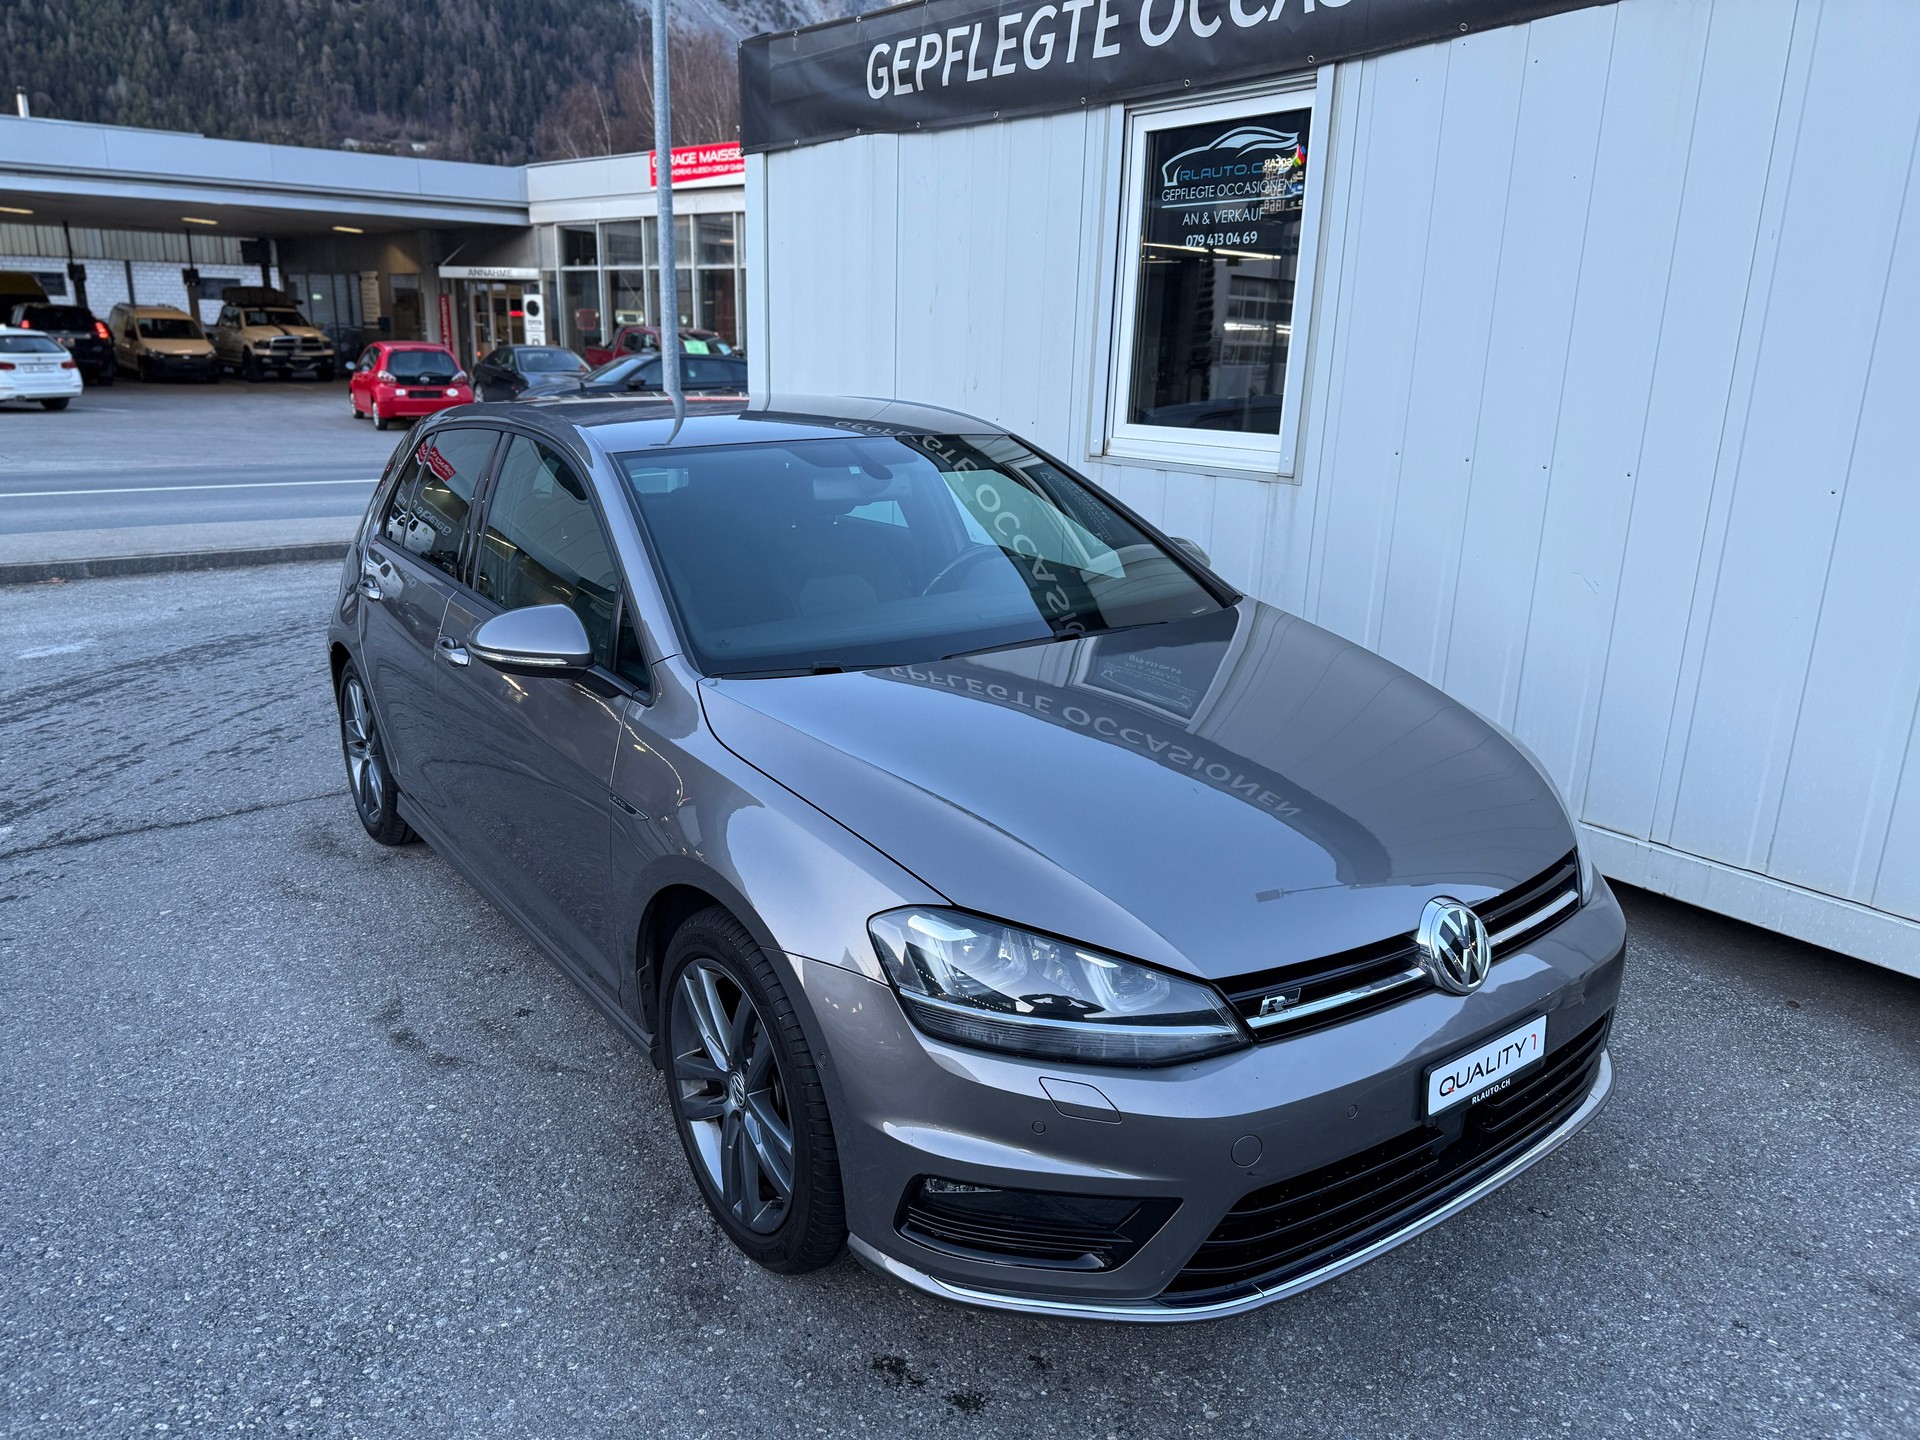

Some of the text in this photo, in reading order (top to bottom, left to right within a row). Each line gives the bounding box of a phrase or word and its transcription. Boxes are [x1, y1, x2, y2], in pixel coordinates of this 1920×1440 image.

[866, 0, 1120, 99] GEPFLEGTE
[1180, 162, 1272, 181] RLAUTO.C
[1161, 185, 1215, 202] GEPFLEGTE
[1216, 178, 1293, 197] OCCASIONEN
[1181, 207, 1265, 226] AN & VERKAUF
[1186, 230, 1258, 247] 079 413 04 69
[467, 268, 514, 278] ANNAHME
[1439, 1037, 1527, 1097] QUALITY
[1471, 1078, 1511, 1105] RLAUTO.CH
